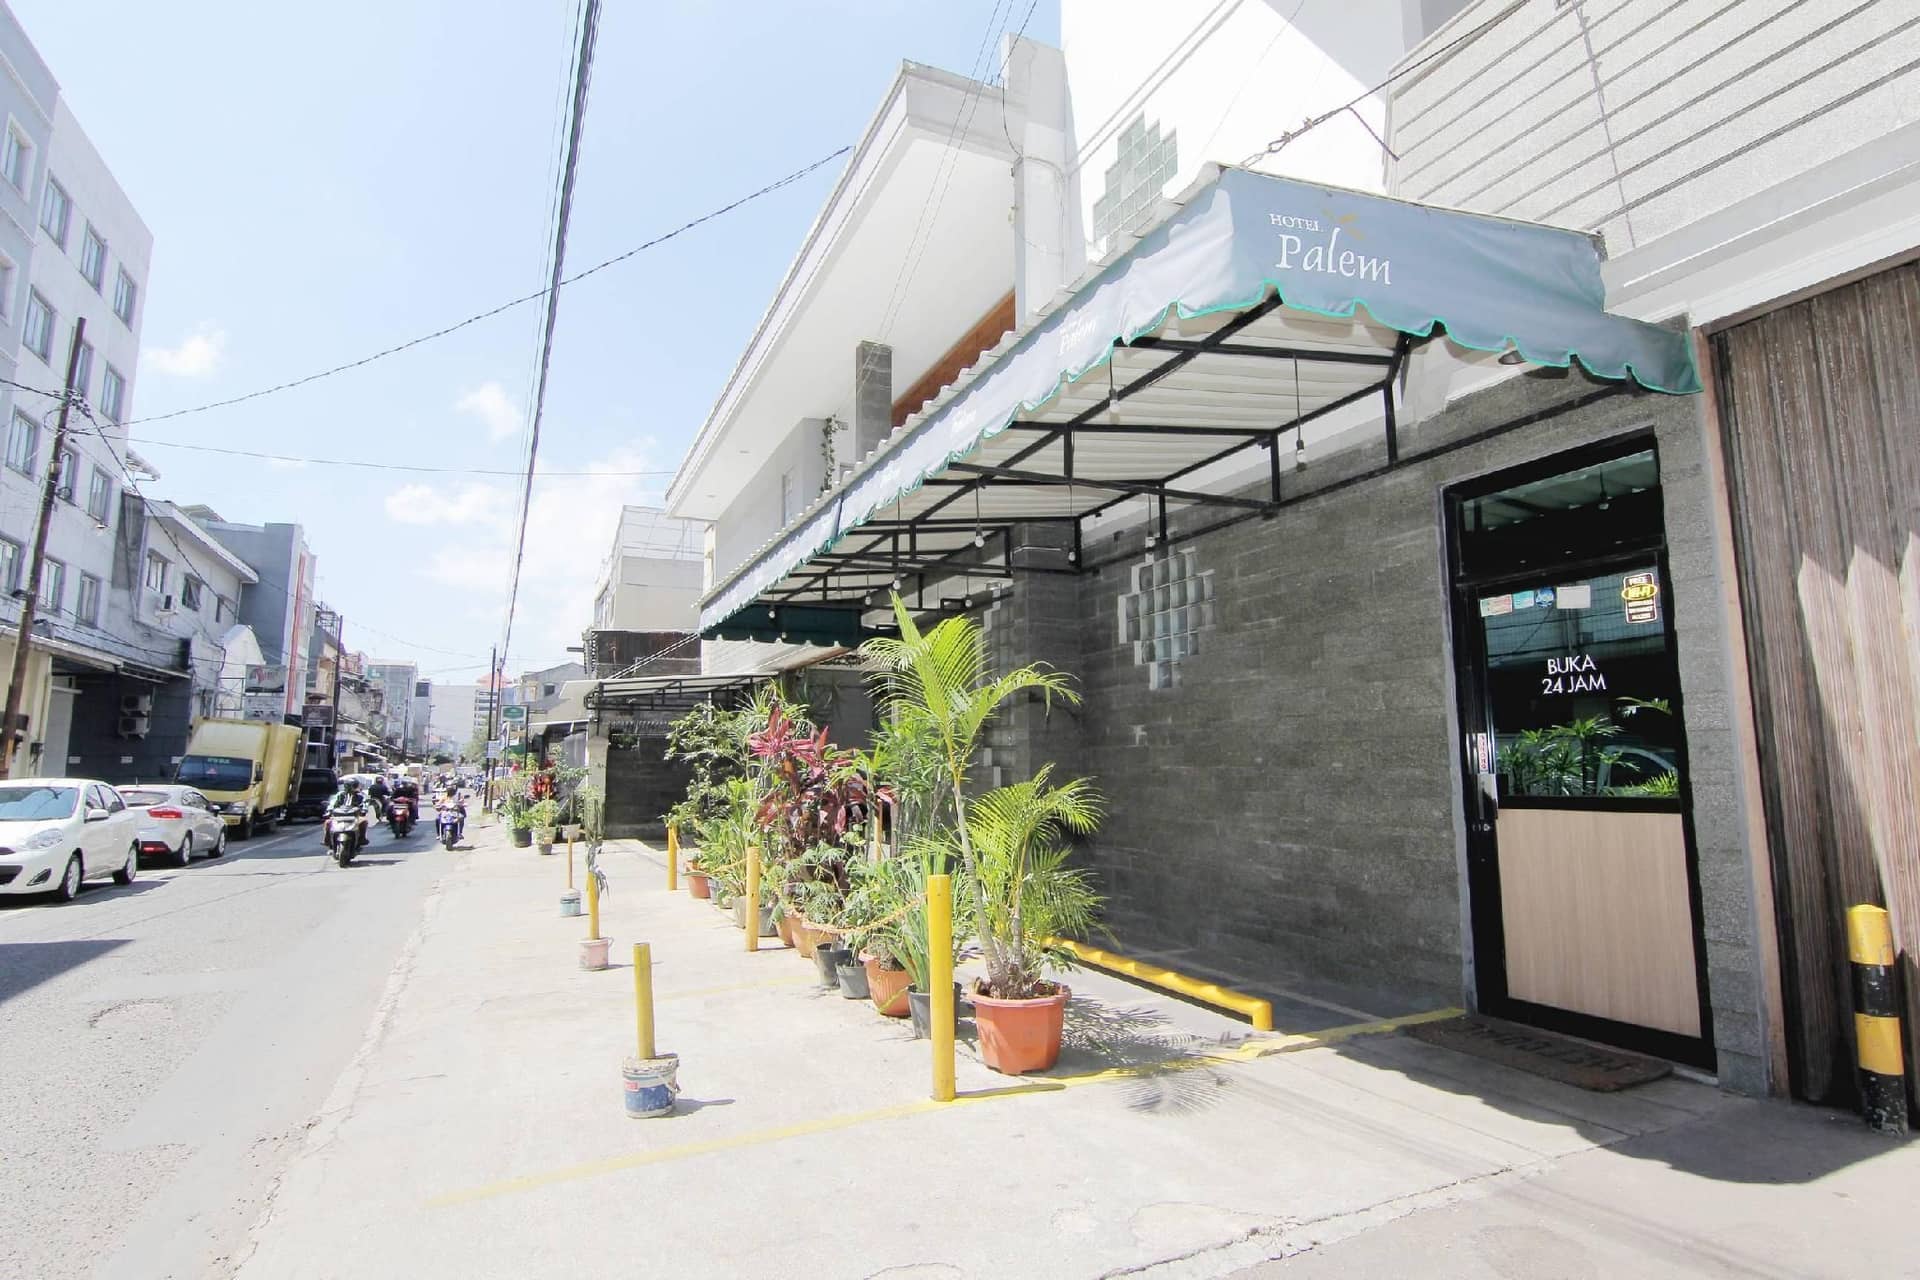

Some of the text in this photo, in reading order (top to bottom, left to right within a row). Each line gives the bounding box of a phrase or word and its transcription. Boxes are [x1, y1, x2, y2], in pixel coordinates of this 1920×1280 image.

[1269, 213, 1323, 232] HOTEL
[1275, 227, 1392, 285] Palem
[1547, 654, 1597, 675] BUKA
[1542, 673, 1607, 694] 24 JAM
